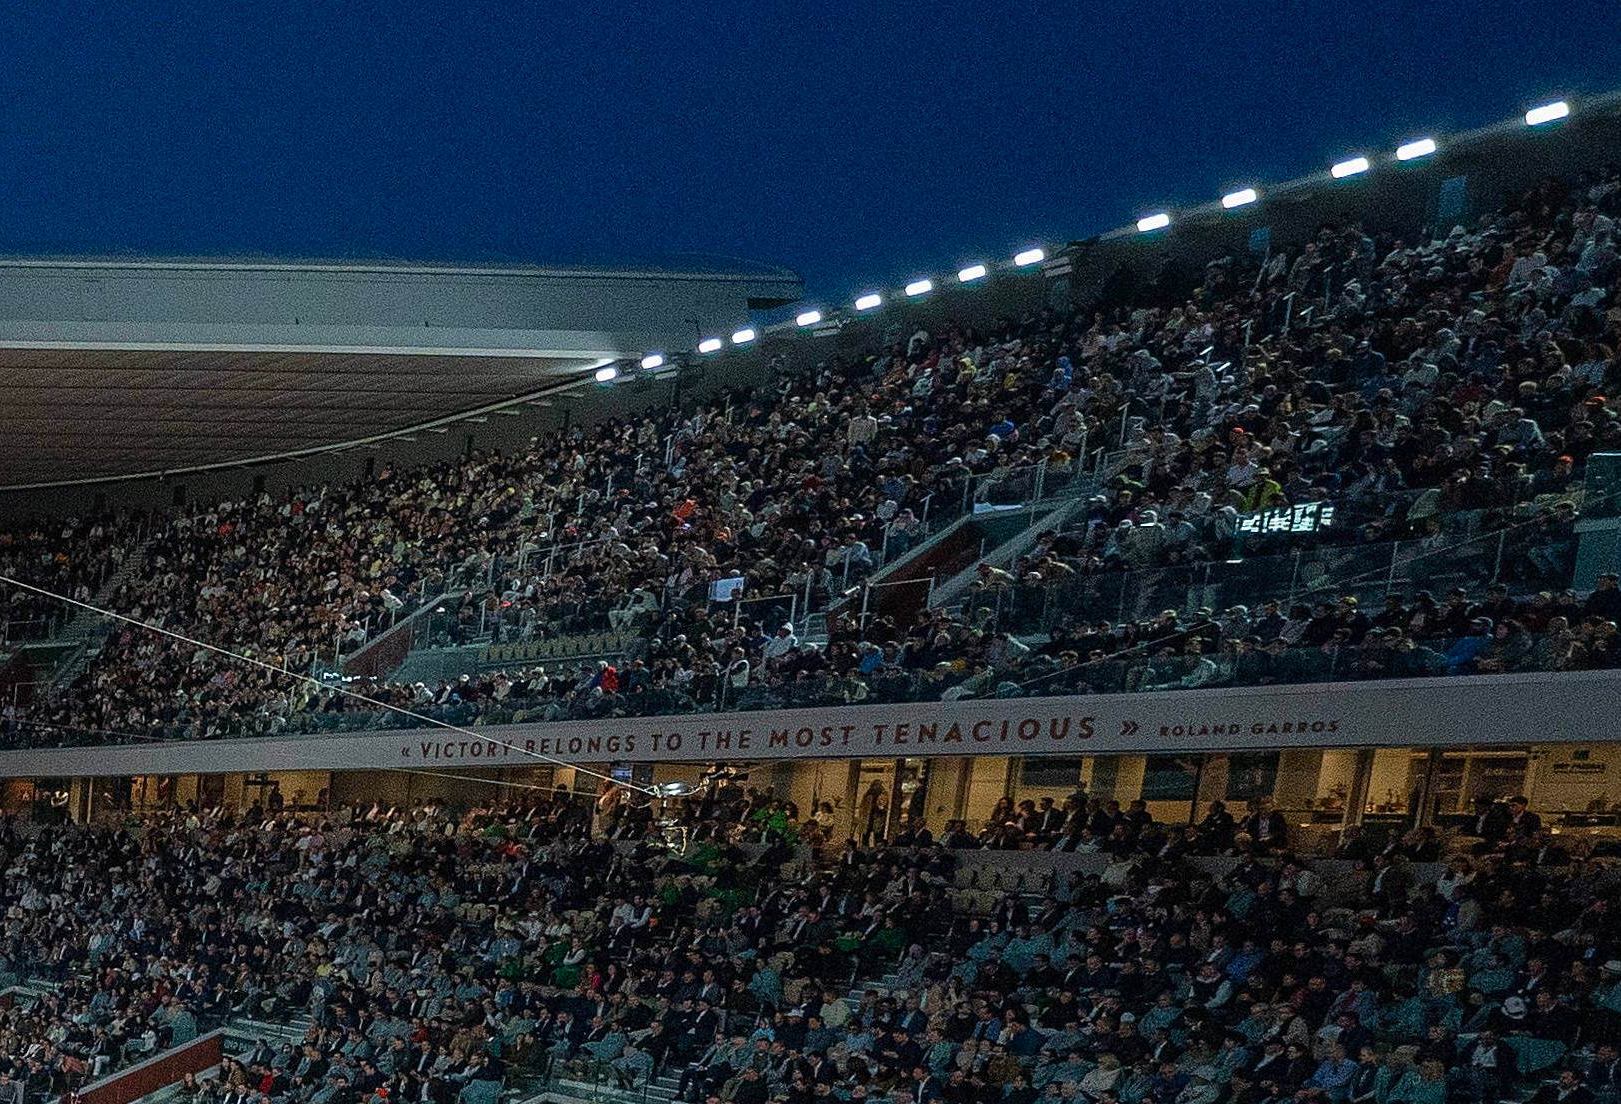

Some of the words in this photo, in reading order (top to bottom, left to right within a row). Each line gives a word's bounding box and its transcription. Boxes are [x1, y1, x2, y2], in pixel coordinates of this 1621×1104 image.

[420, 740, 513, 759] VICTORY
[525, 734, 636, 756] BELONGS
[650, 733, 682, 752] TO
[698, 730, 752, 749] THE
[769, 725, 855, 748] MOST
[874, 716, 1096, 744] TENACIOUS
[1160, 723, 1241, 738] ROLAND
[1251, 719, 1339, 735] GARROS
